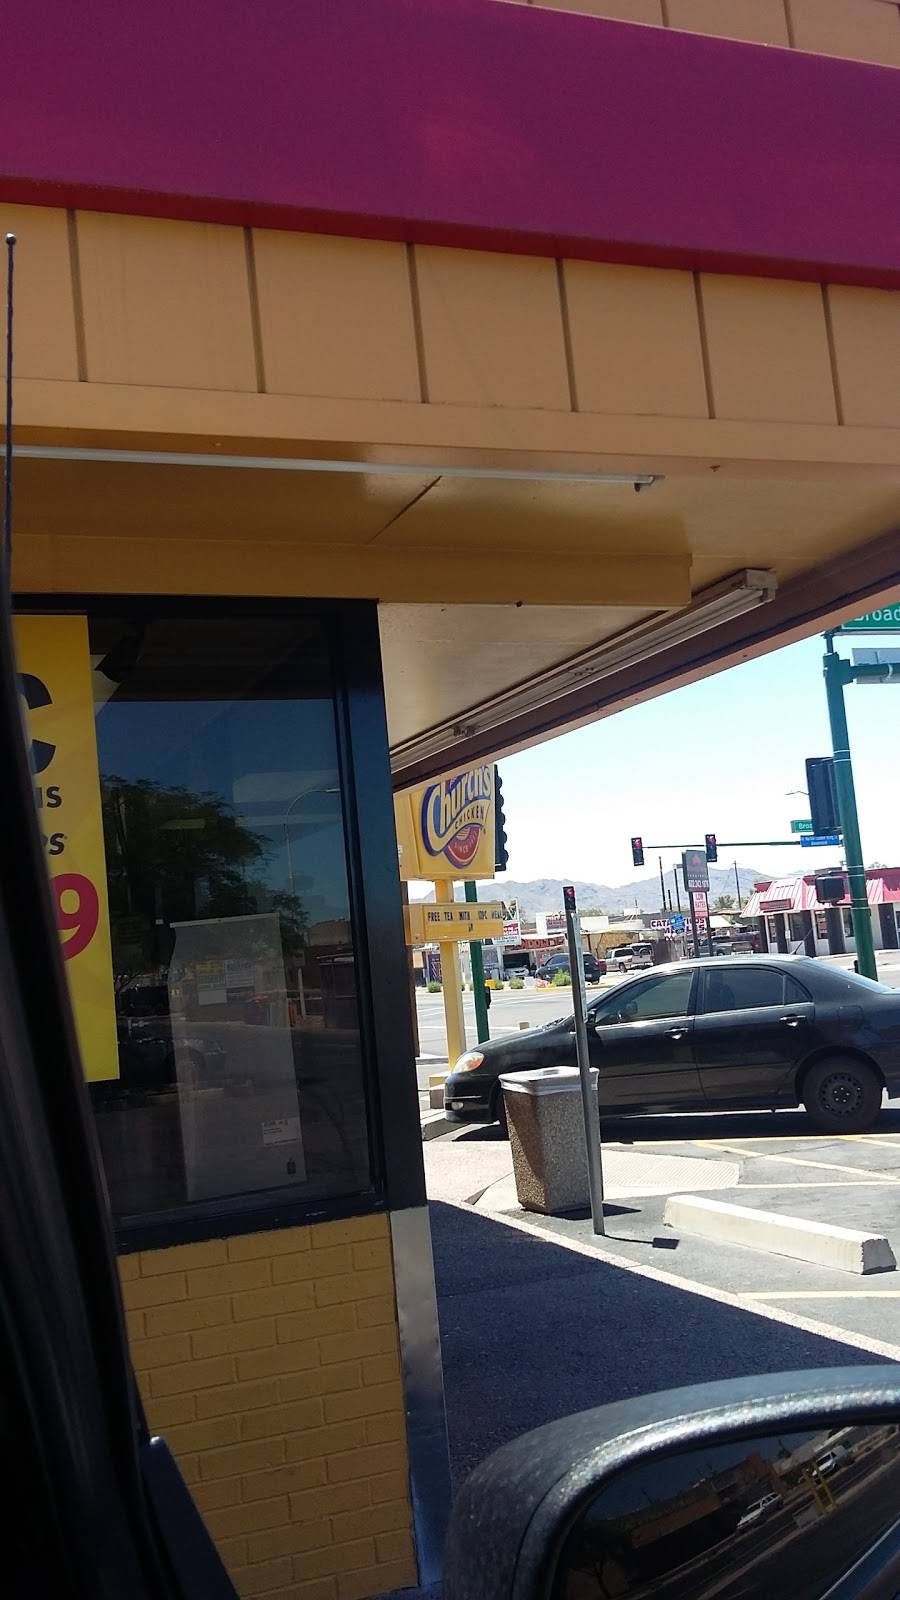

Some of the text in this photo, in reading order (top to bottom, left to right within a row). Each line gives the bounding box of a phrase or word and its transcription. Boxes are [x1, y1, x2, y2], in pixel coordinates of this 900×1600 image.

[853, 606, 900, 621] road
[455, 805, 484, 829] CHICKEN
[428, 911, 441, 922] FREE
[444, 911, 453, 921] TEA
